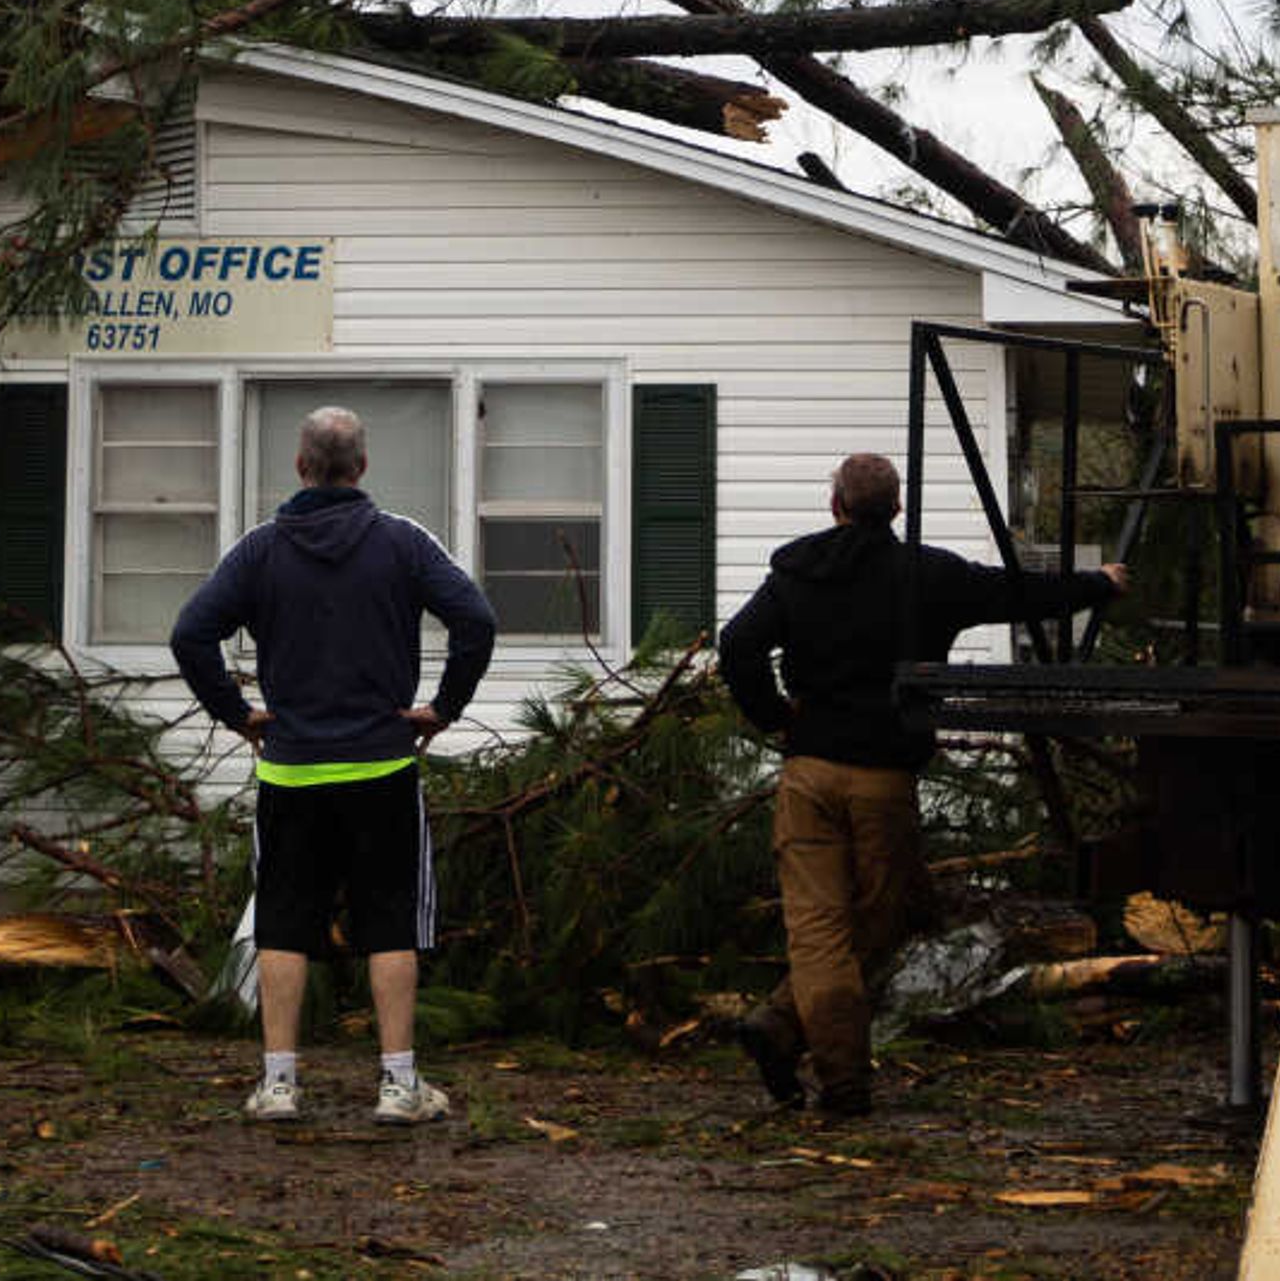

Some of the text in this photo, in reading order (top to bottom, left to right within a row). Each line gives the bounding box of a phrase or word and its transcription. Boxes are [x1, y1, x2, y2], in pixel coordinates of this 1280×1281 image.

[159, 245, 324, 281] OFFICE
[188, 290, 234, 317] MO
[86, 324, 161, 351] 63751
